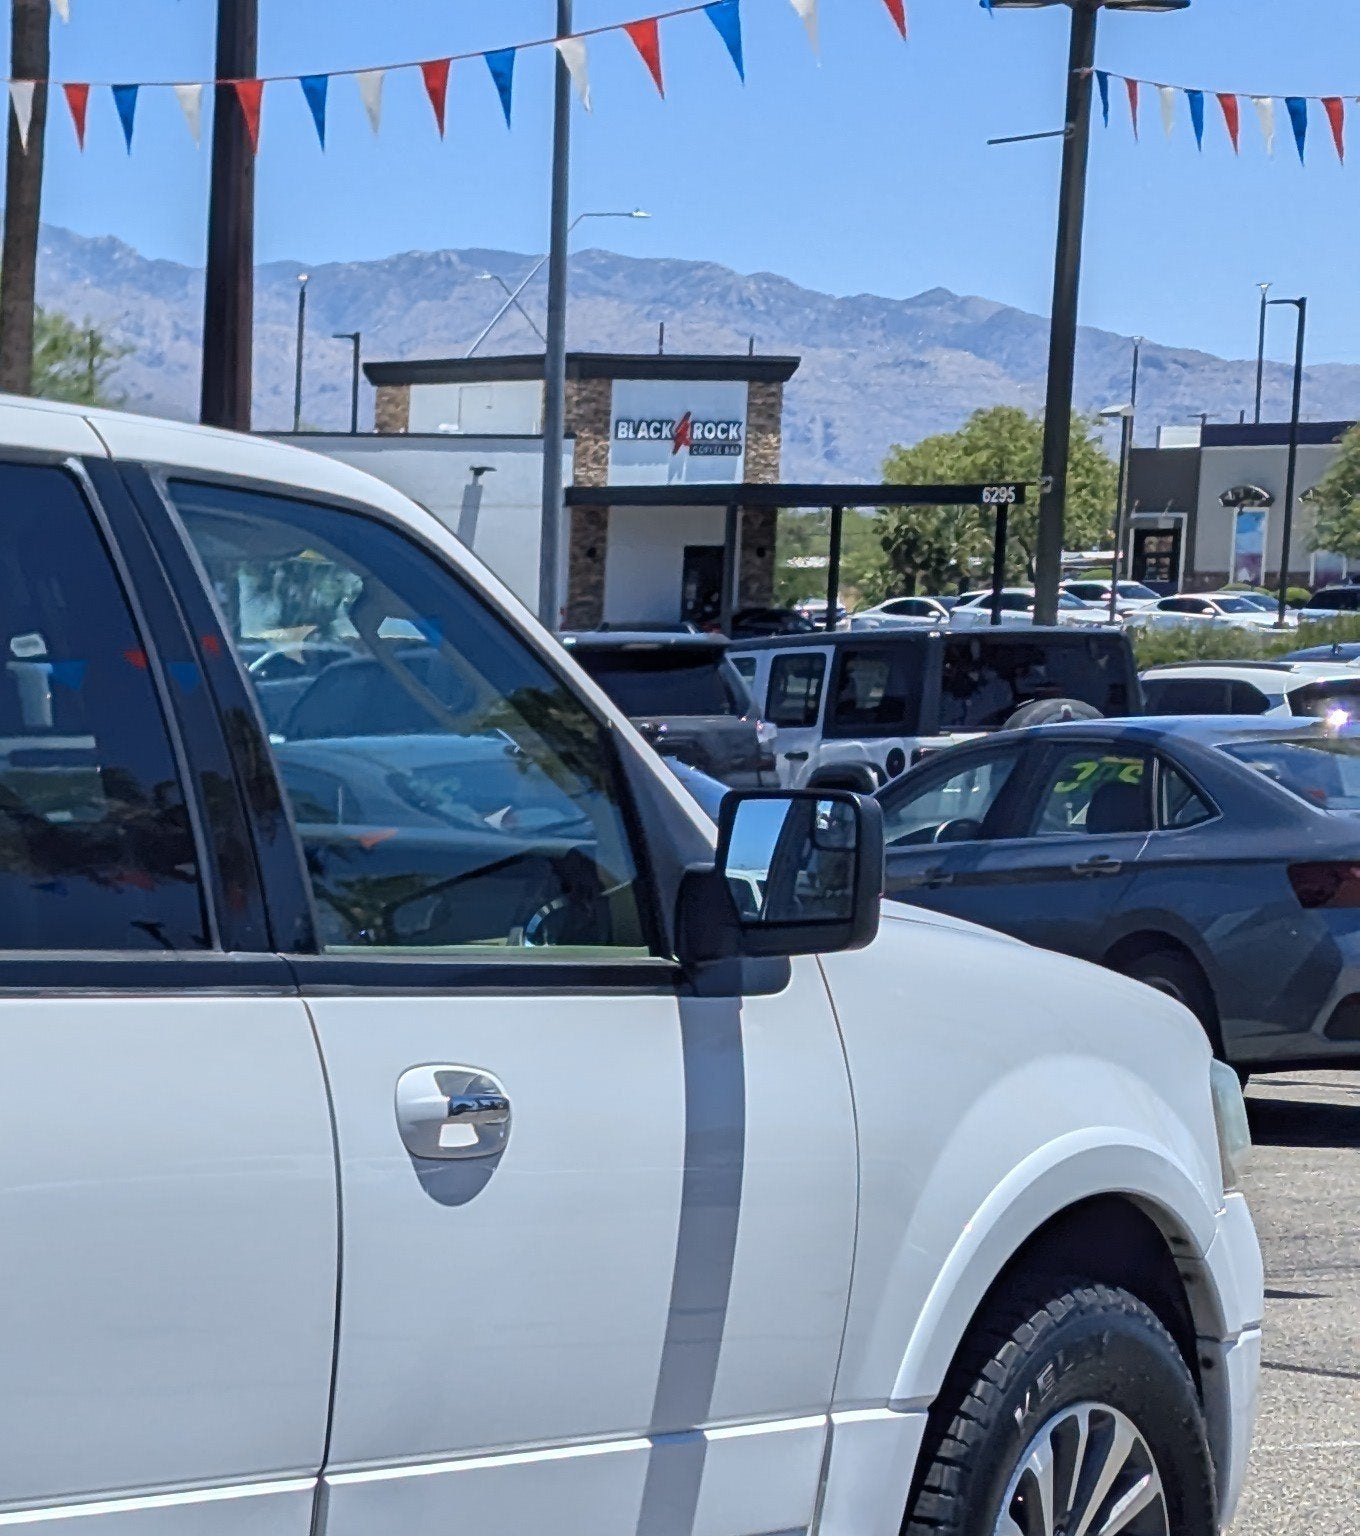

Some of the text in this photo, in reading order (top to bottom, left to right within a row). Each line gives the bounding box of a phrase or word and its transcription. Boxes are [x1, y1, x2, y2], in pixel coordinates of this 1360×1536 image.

[617, 421, 742, 440] BLACK ROCK
[982, 486, 1015, 503] 6295
